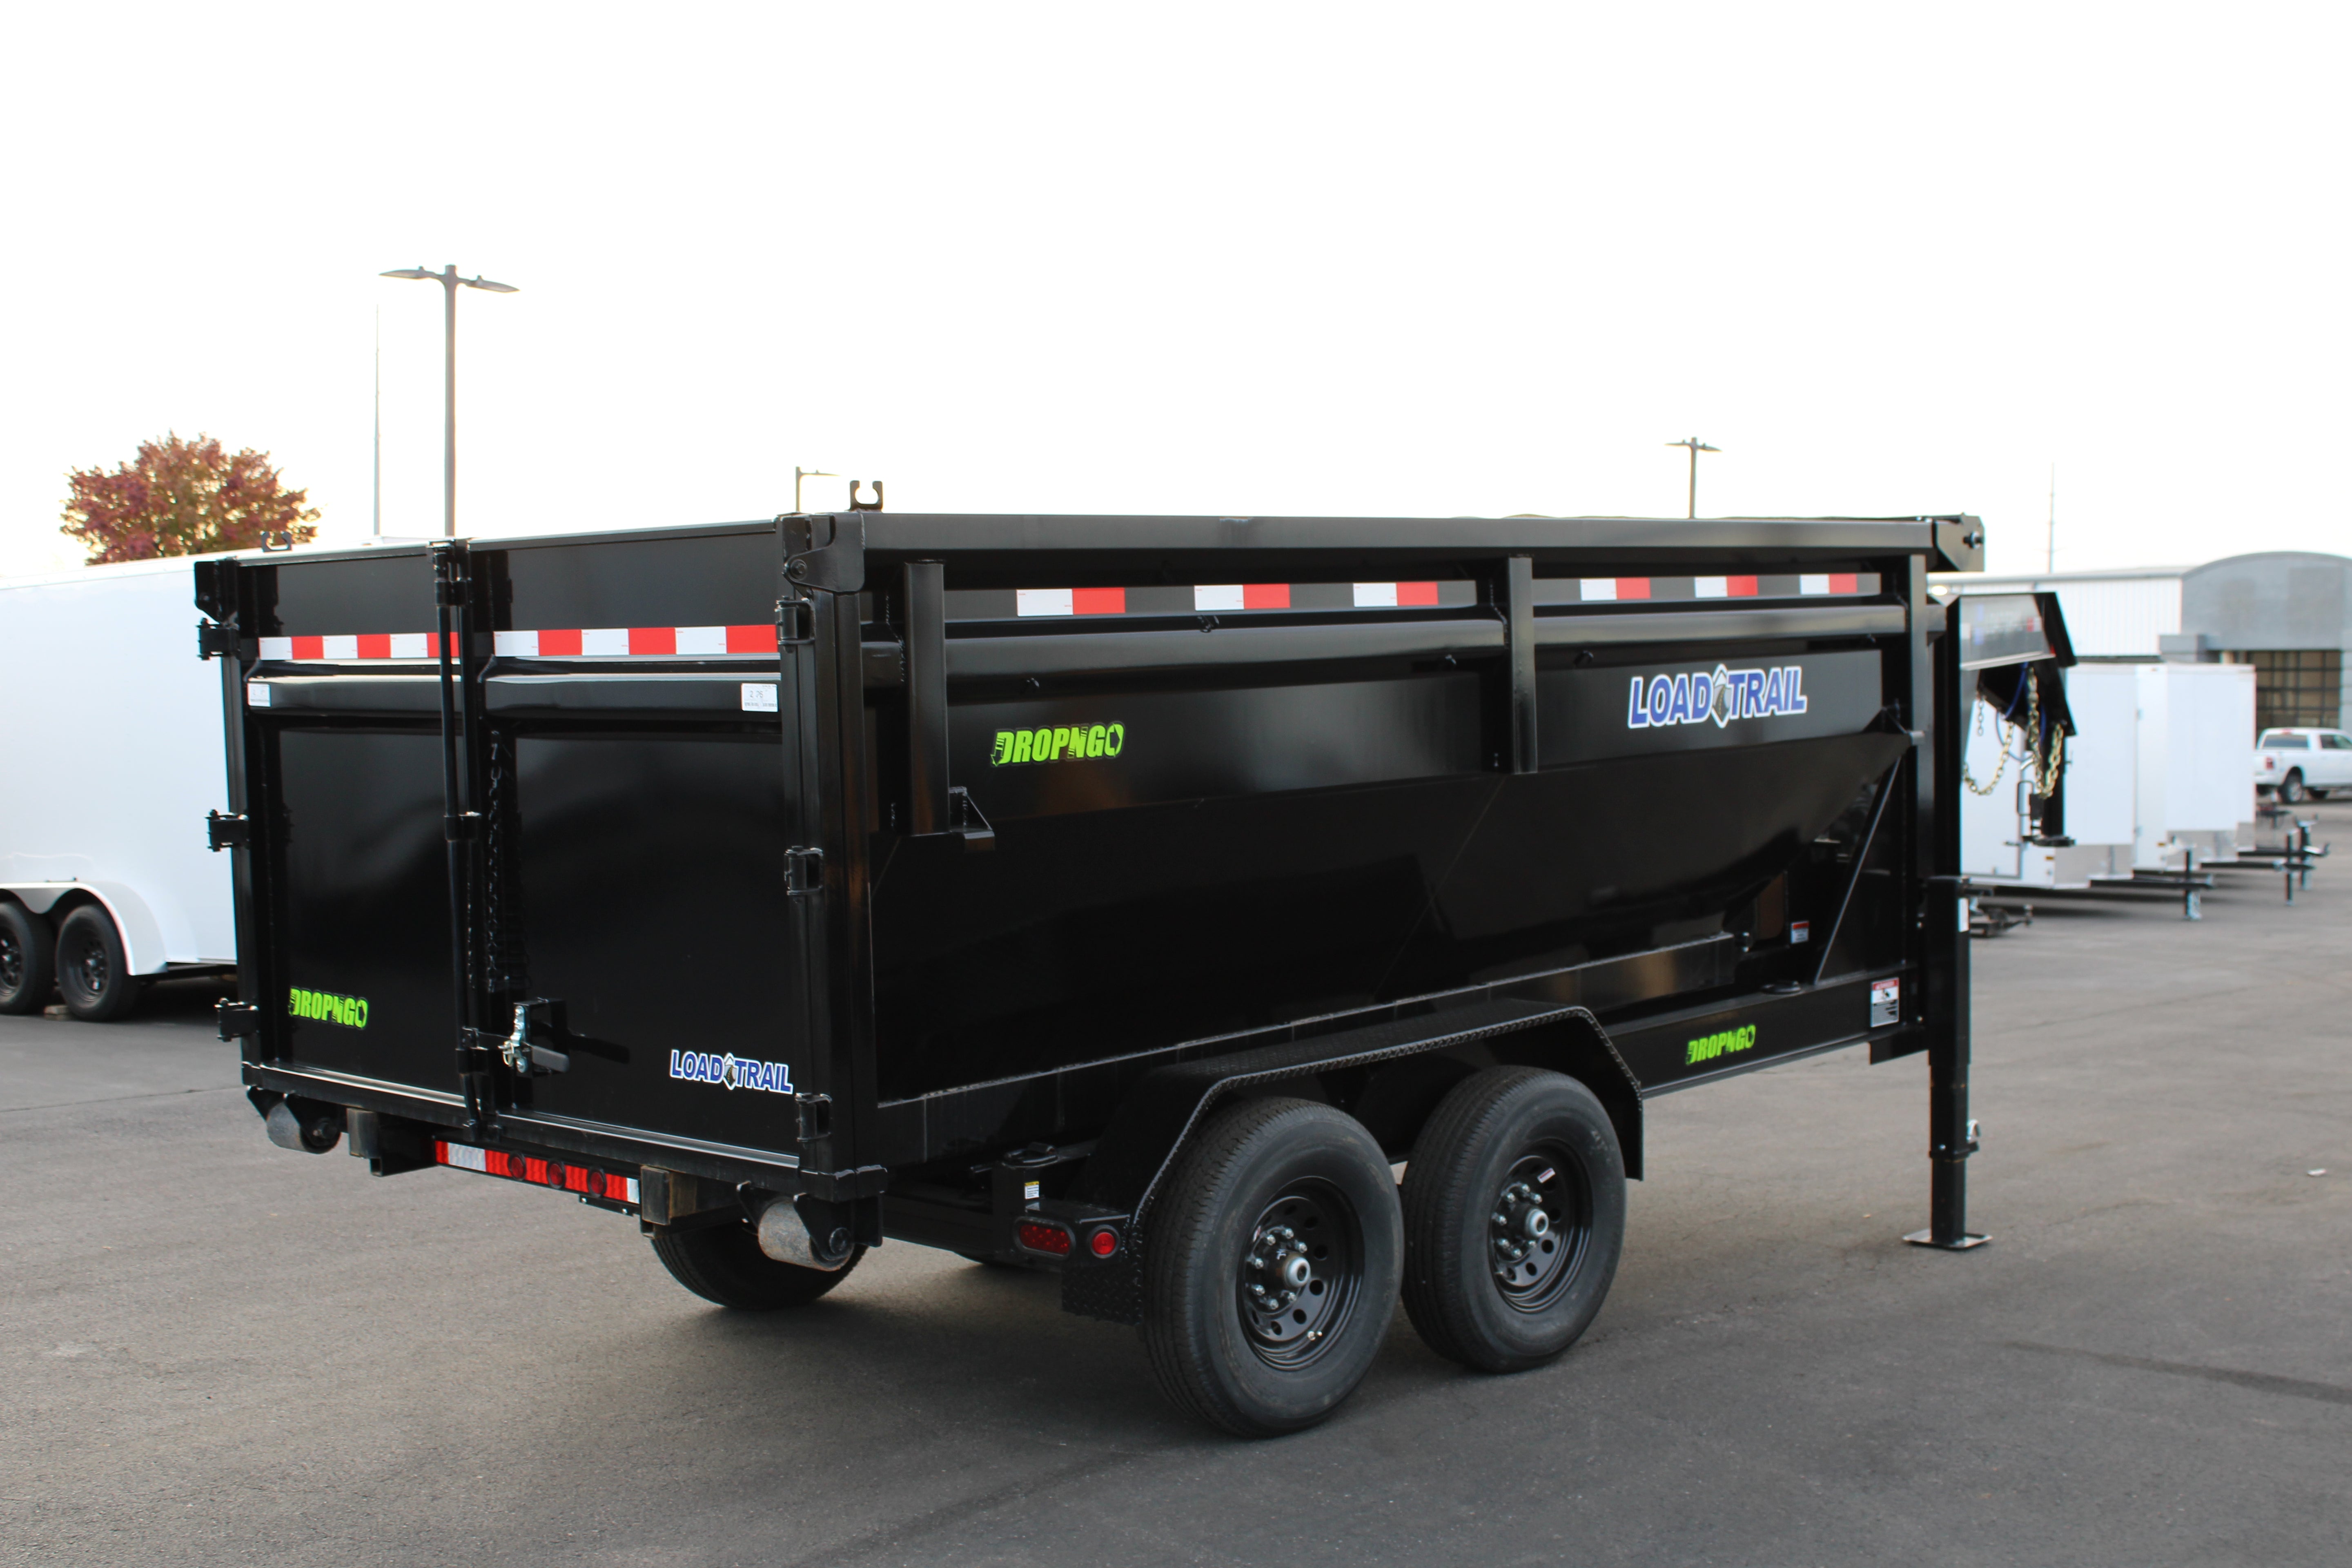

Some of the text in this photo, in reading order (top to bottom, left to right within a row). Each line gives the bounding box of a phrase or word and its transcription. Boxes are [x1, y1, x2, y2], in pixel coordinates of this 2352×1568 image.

[1628, 666, 1808, 728] LOAD TRAIL
[670, 1049, 793, 1095] LOAD TRAIL
